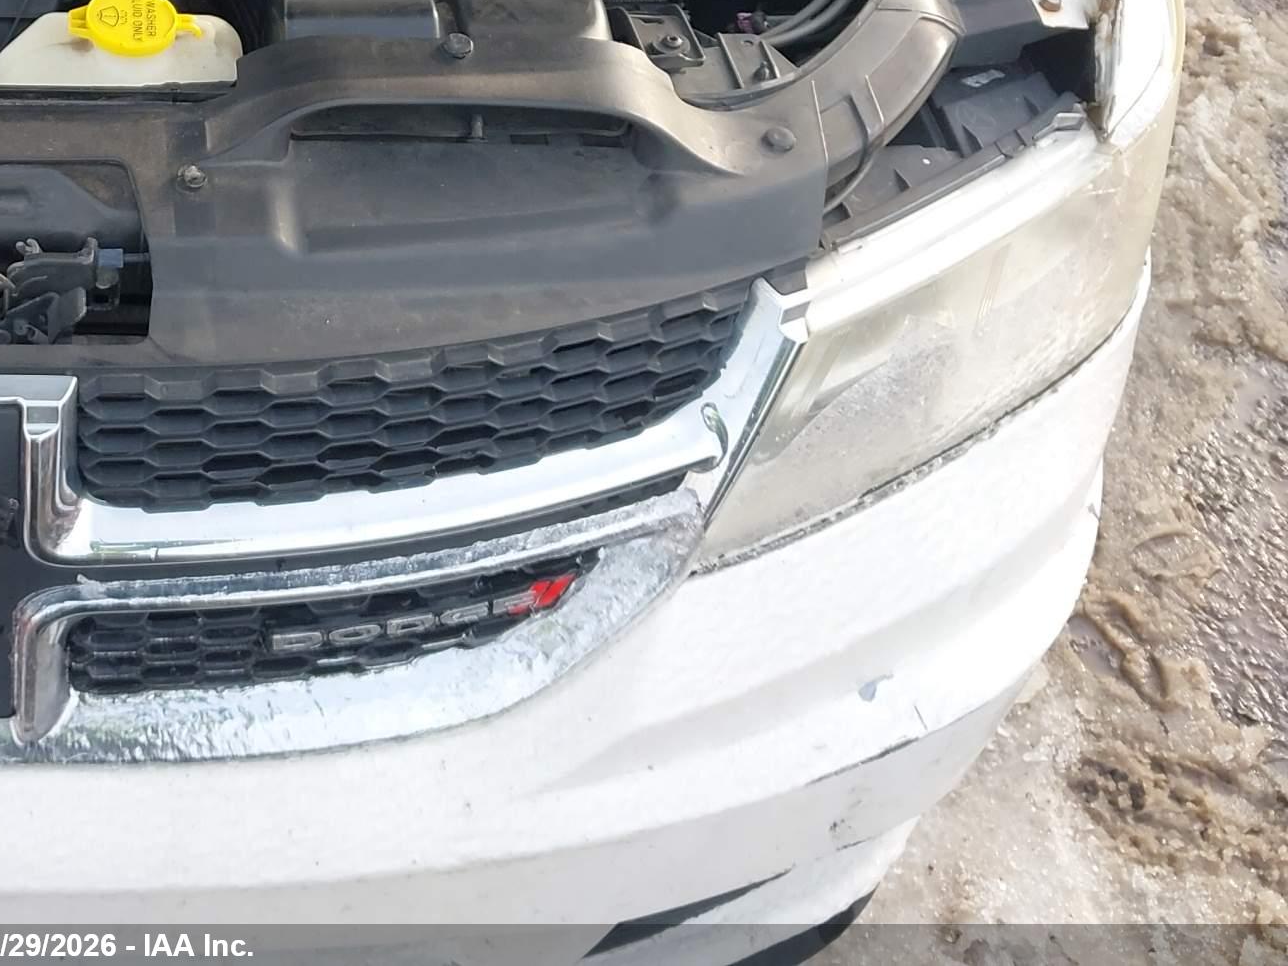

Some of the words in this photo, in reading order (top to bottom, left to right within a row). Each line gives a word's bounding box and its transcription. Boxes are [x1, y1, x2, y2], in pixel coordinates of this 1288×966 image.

[132, 19, 144, 43] ONLY
[145, 0, 157, 38] WASHER
[270, 589, 536, 652] DODGE
